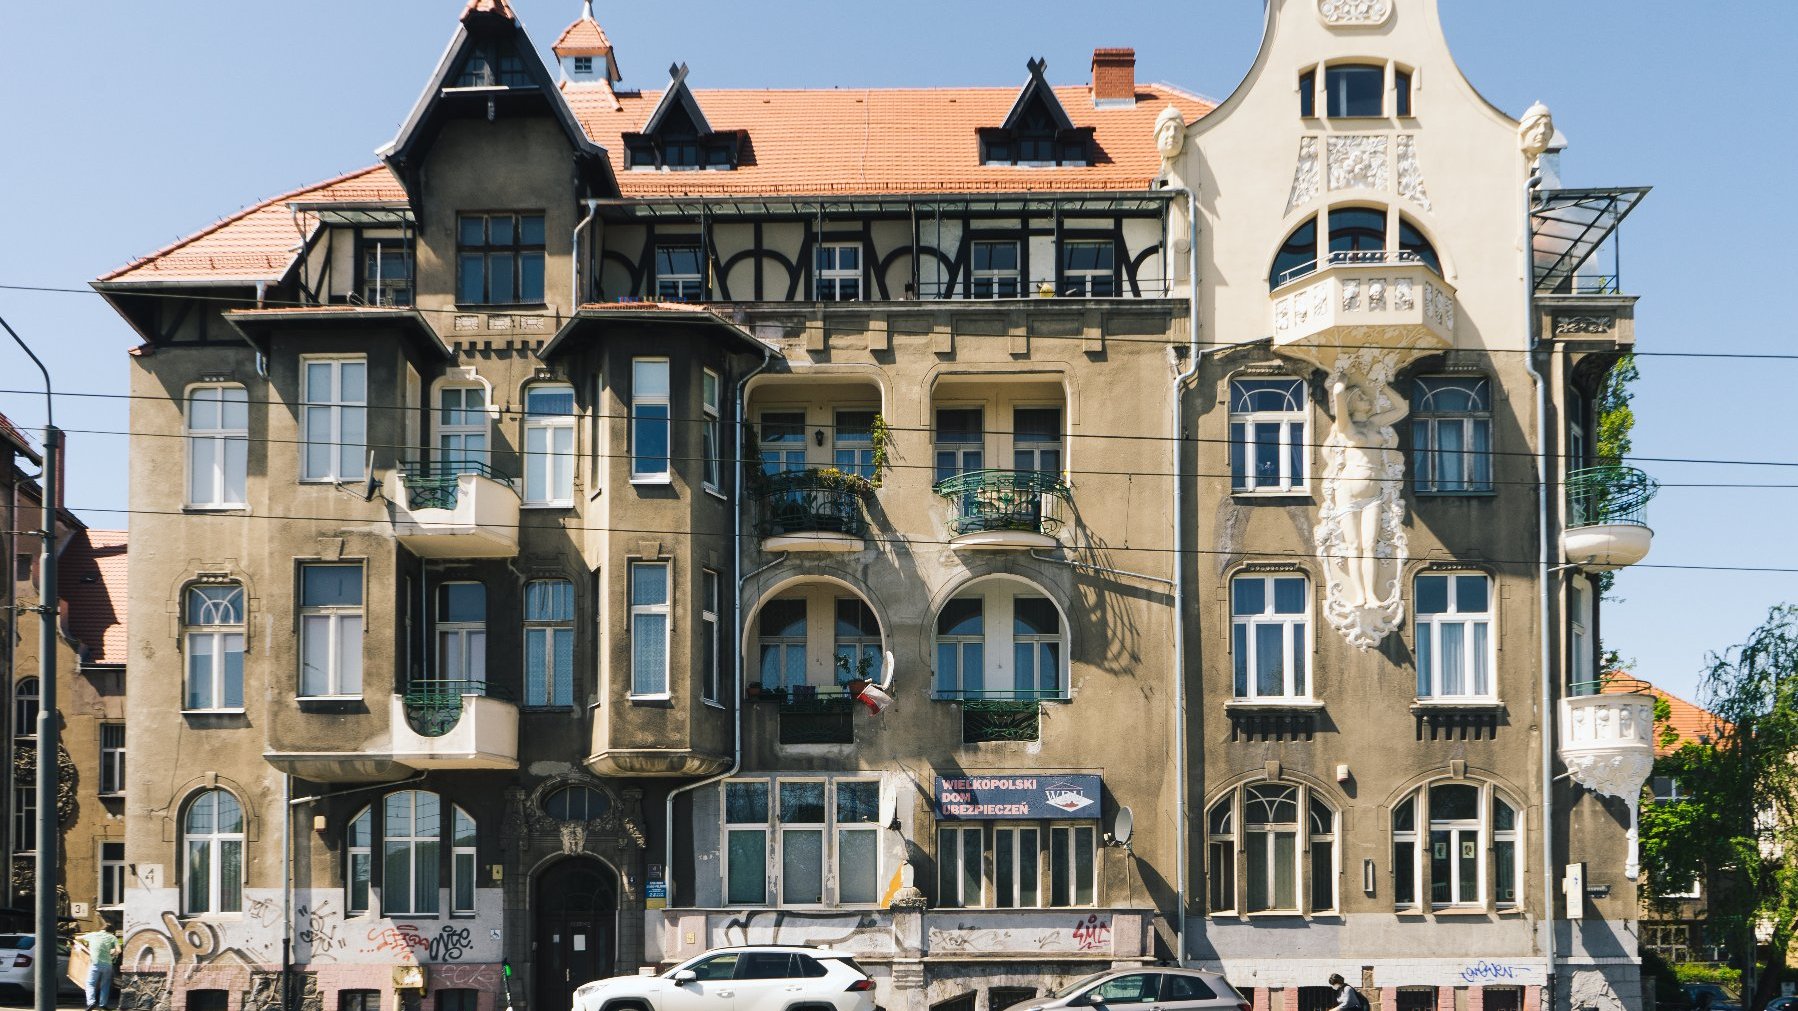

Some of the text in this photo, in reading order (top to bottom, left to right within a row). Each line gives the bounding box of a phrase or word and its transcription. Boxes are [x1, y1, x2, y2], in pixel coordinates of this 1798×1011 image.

[941, 779, 1037, 790] WIELKOPOLSKI
[941, 792, 971, 803] DOM
[942, 801, 1029, 815] UBEZPIECZEŃ
